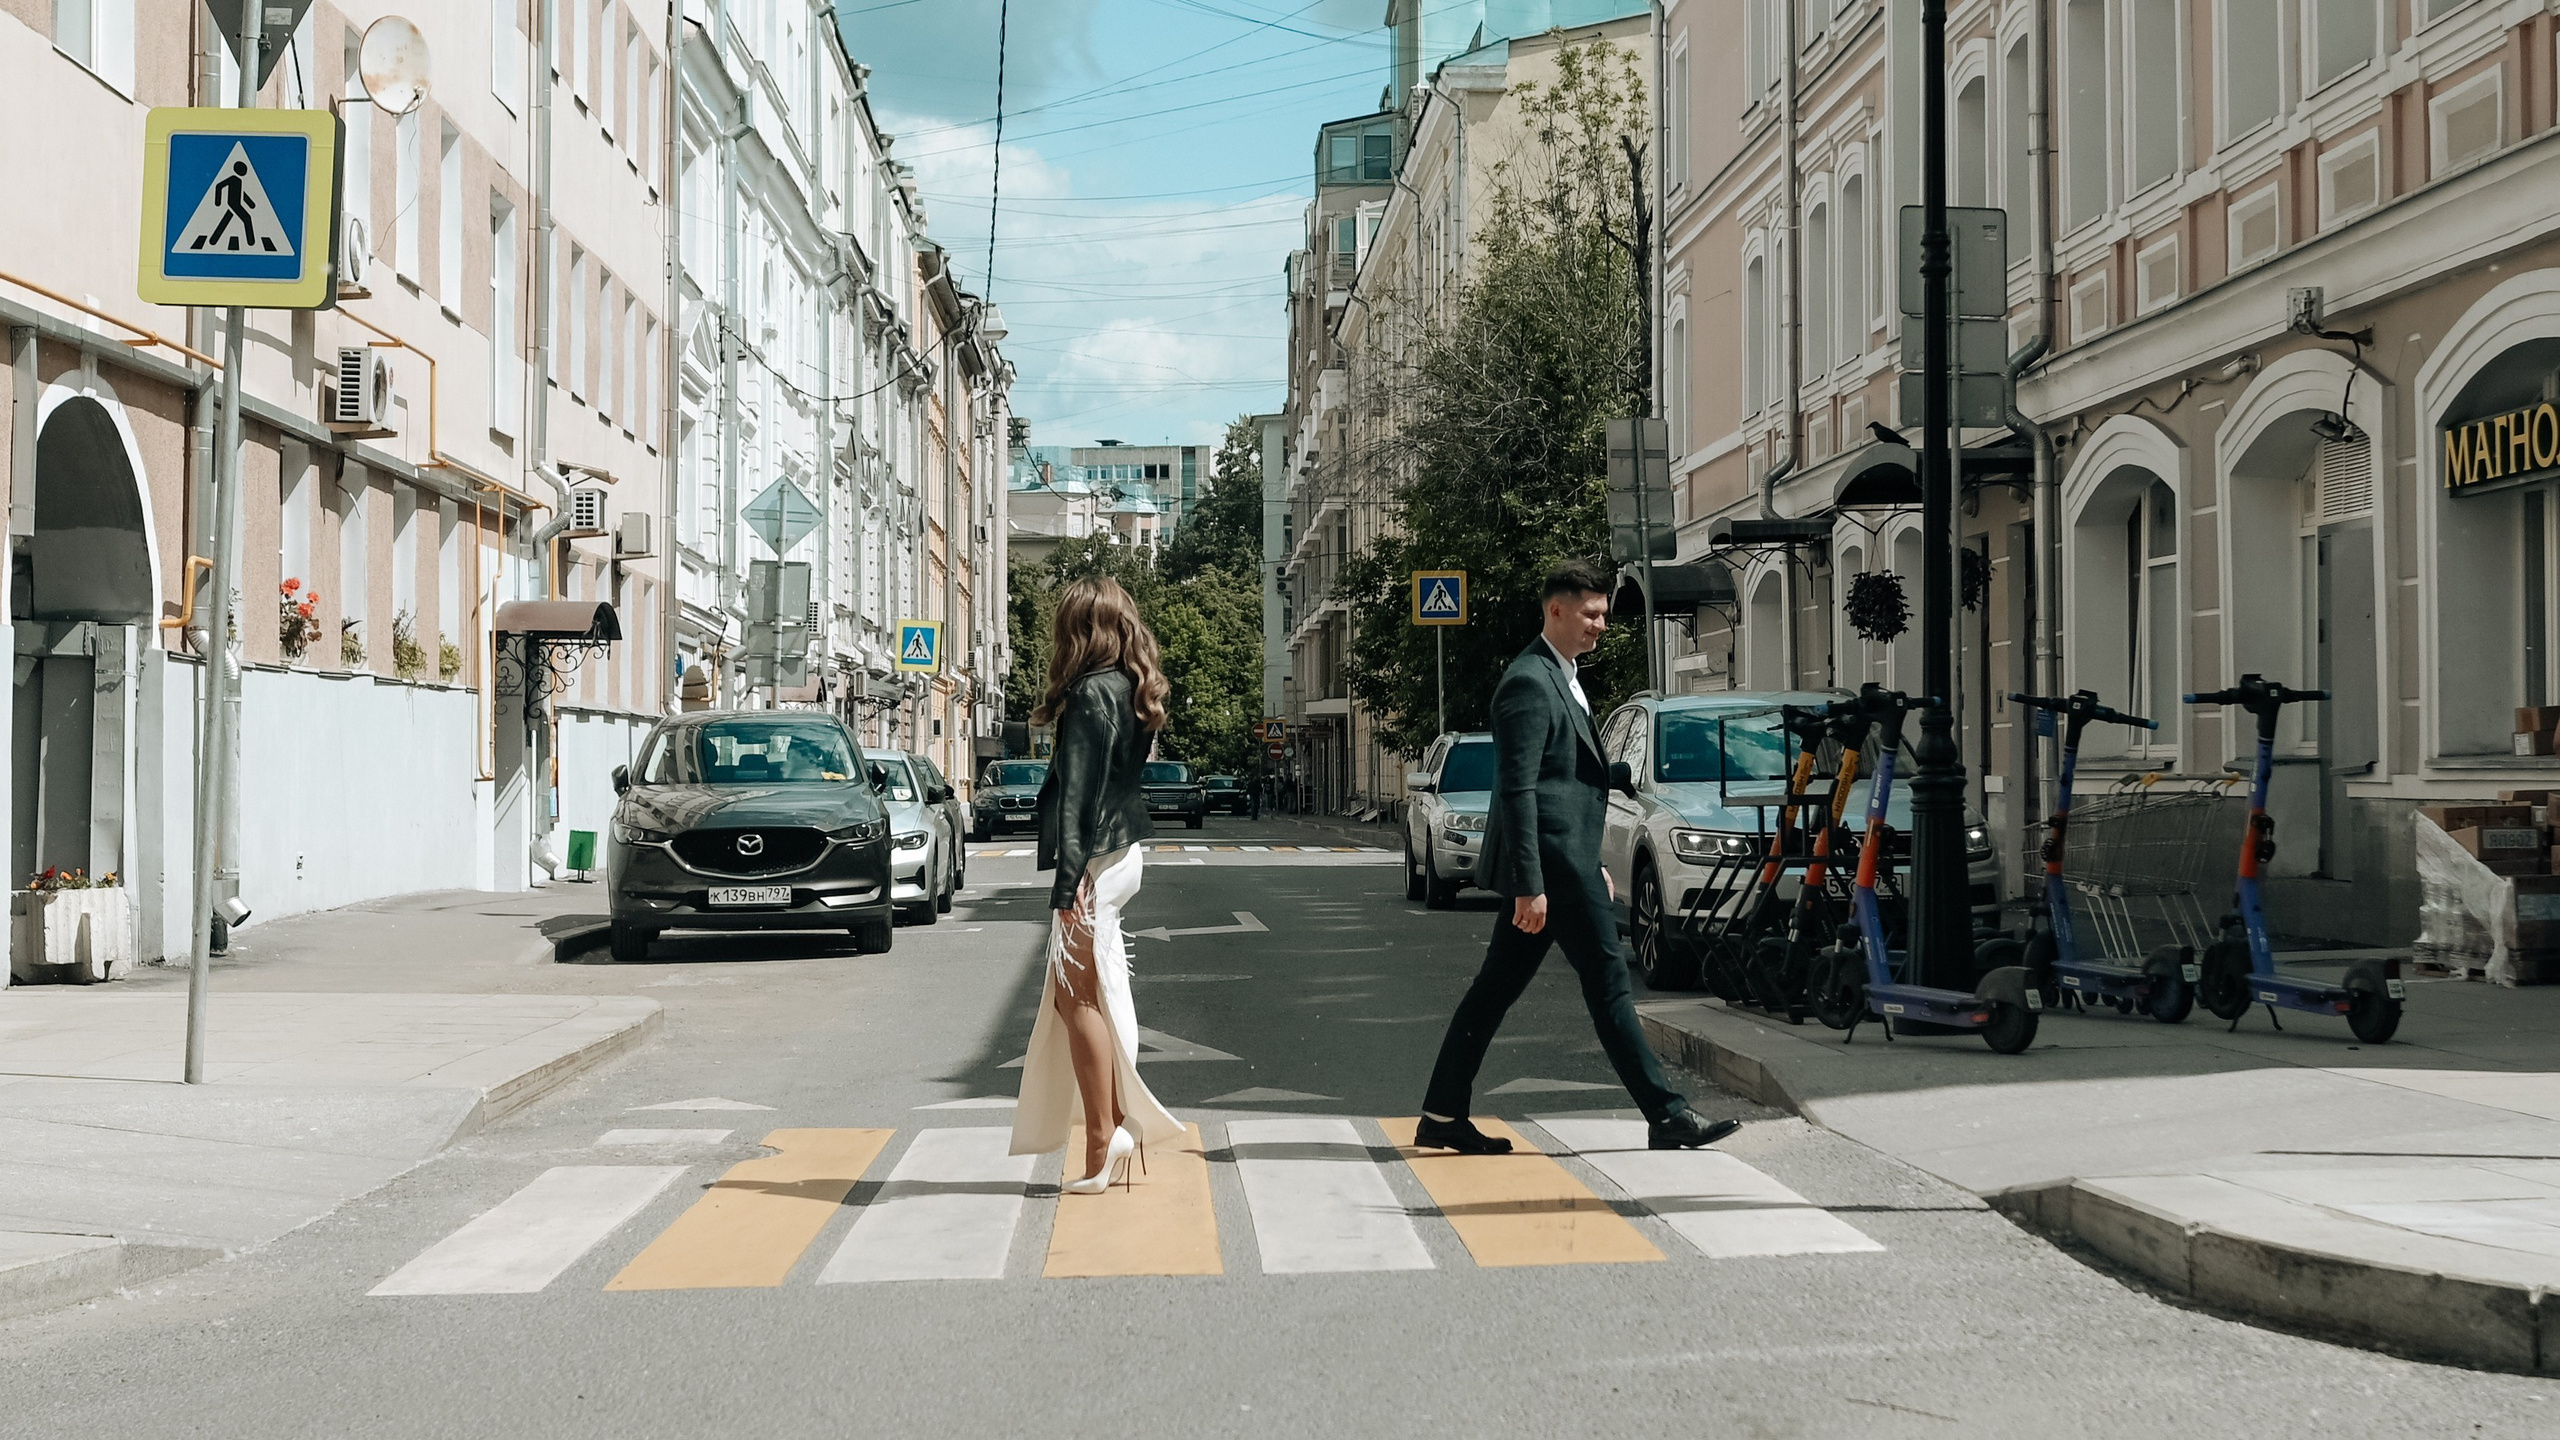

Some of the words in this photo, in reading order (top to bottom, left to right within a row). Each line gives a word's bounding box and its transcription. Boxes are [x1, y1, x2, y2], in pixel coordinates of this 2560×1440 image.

[2444, 403, 2560, 488] МАГНО
[1834, 773, 1851, 812] WHOOSH
[713, 888, 765, 902] К139ВН
[767, 887, 787, 898] 797
